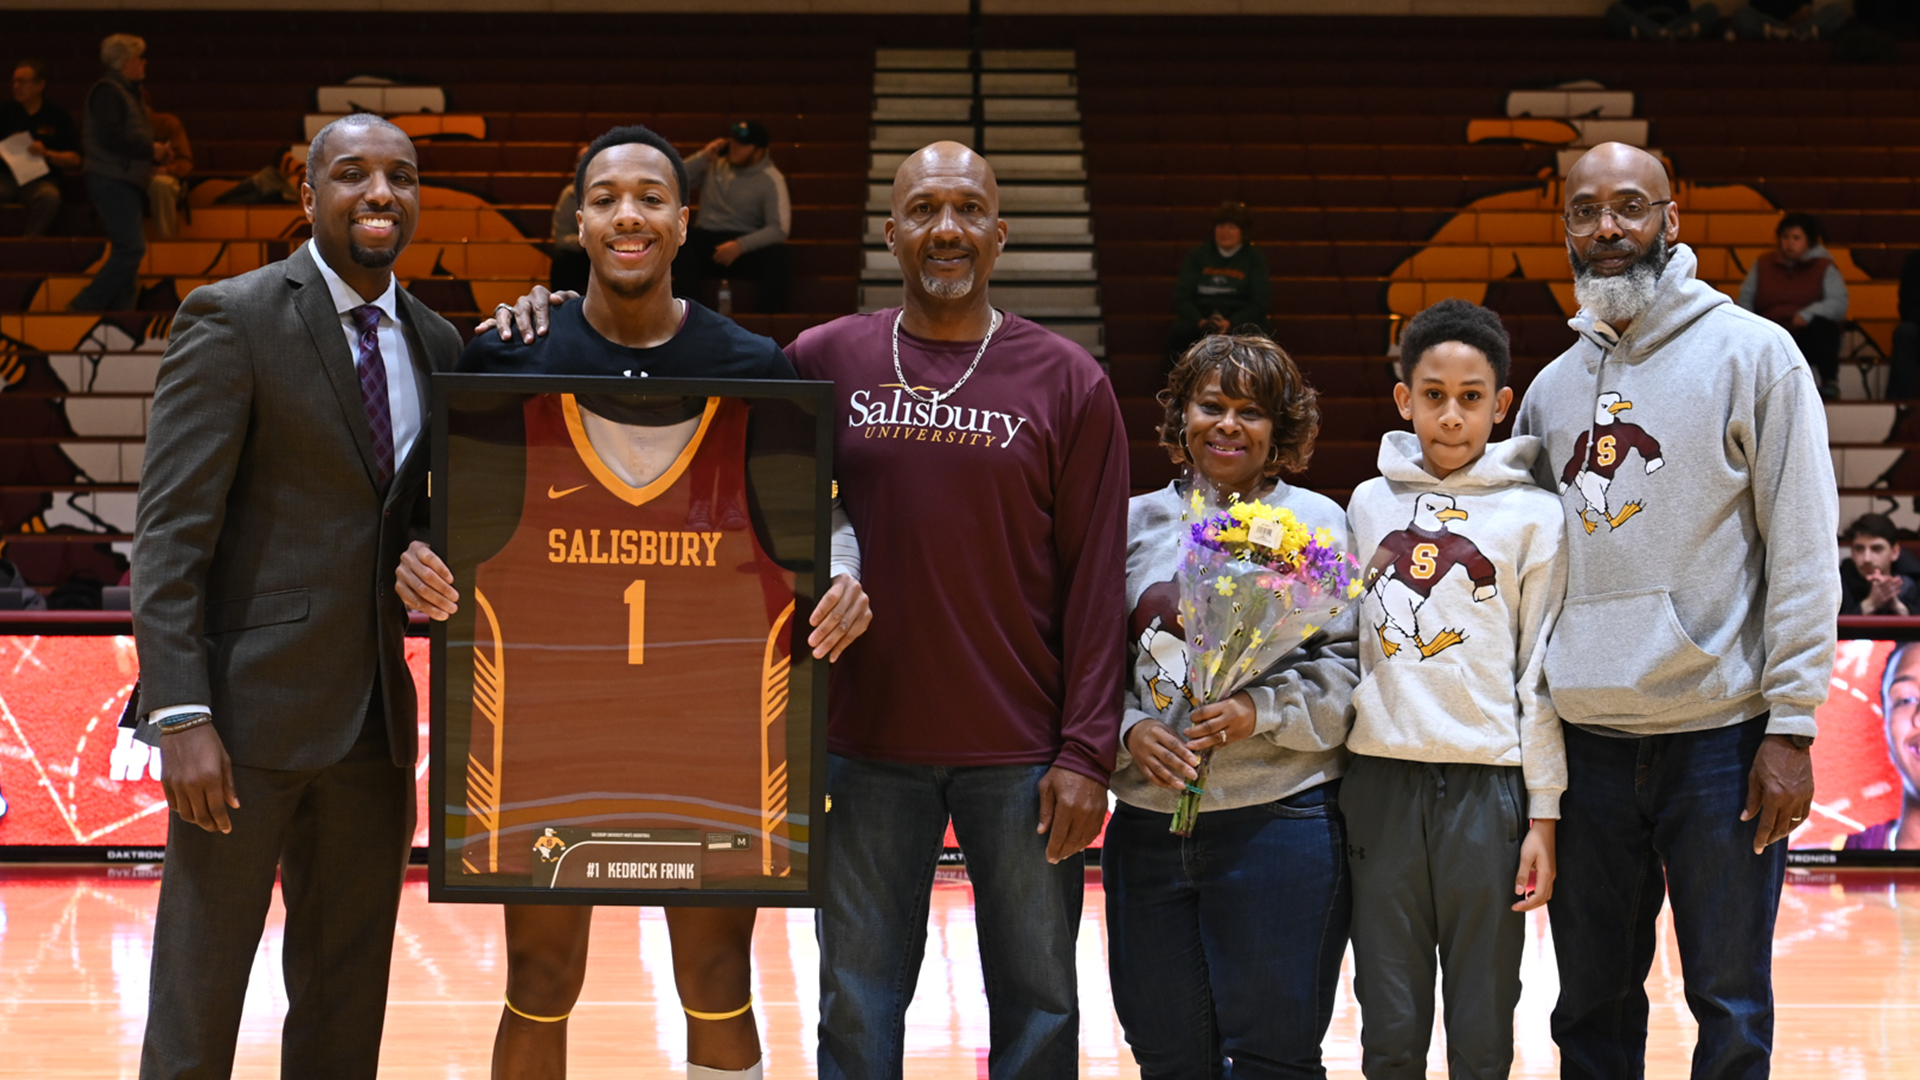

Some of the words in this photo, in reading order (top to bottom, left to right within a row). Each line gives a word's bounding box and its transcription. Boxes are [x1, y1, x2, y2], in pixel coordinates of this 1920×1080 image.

[849, 390, 1026, 448] Salisbury
[864, 426, 997, 447] UNIVERSITY
[1597, 435, 1616, 467] S
[548, 528, 722, 566] SALISBURY
[1410, 543, 1439, 579] S
[624, 579, 646, 665] 1
[737, 838, 746, 846] M
[586, 862, 600, 878] #1
[608, 862, 658, 879] KEDRICK
[661, 863, 695, 879] FRINK
